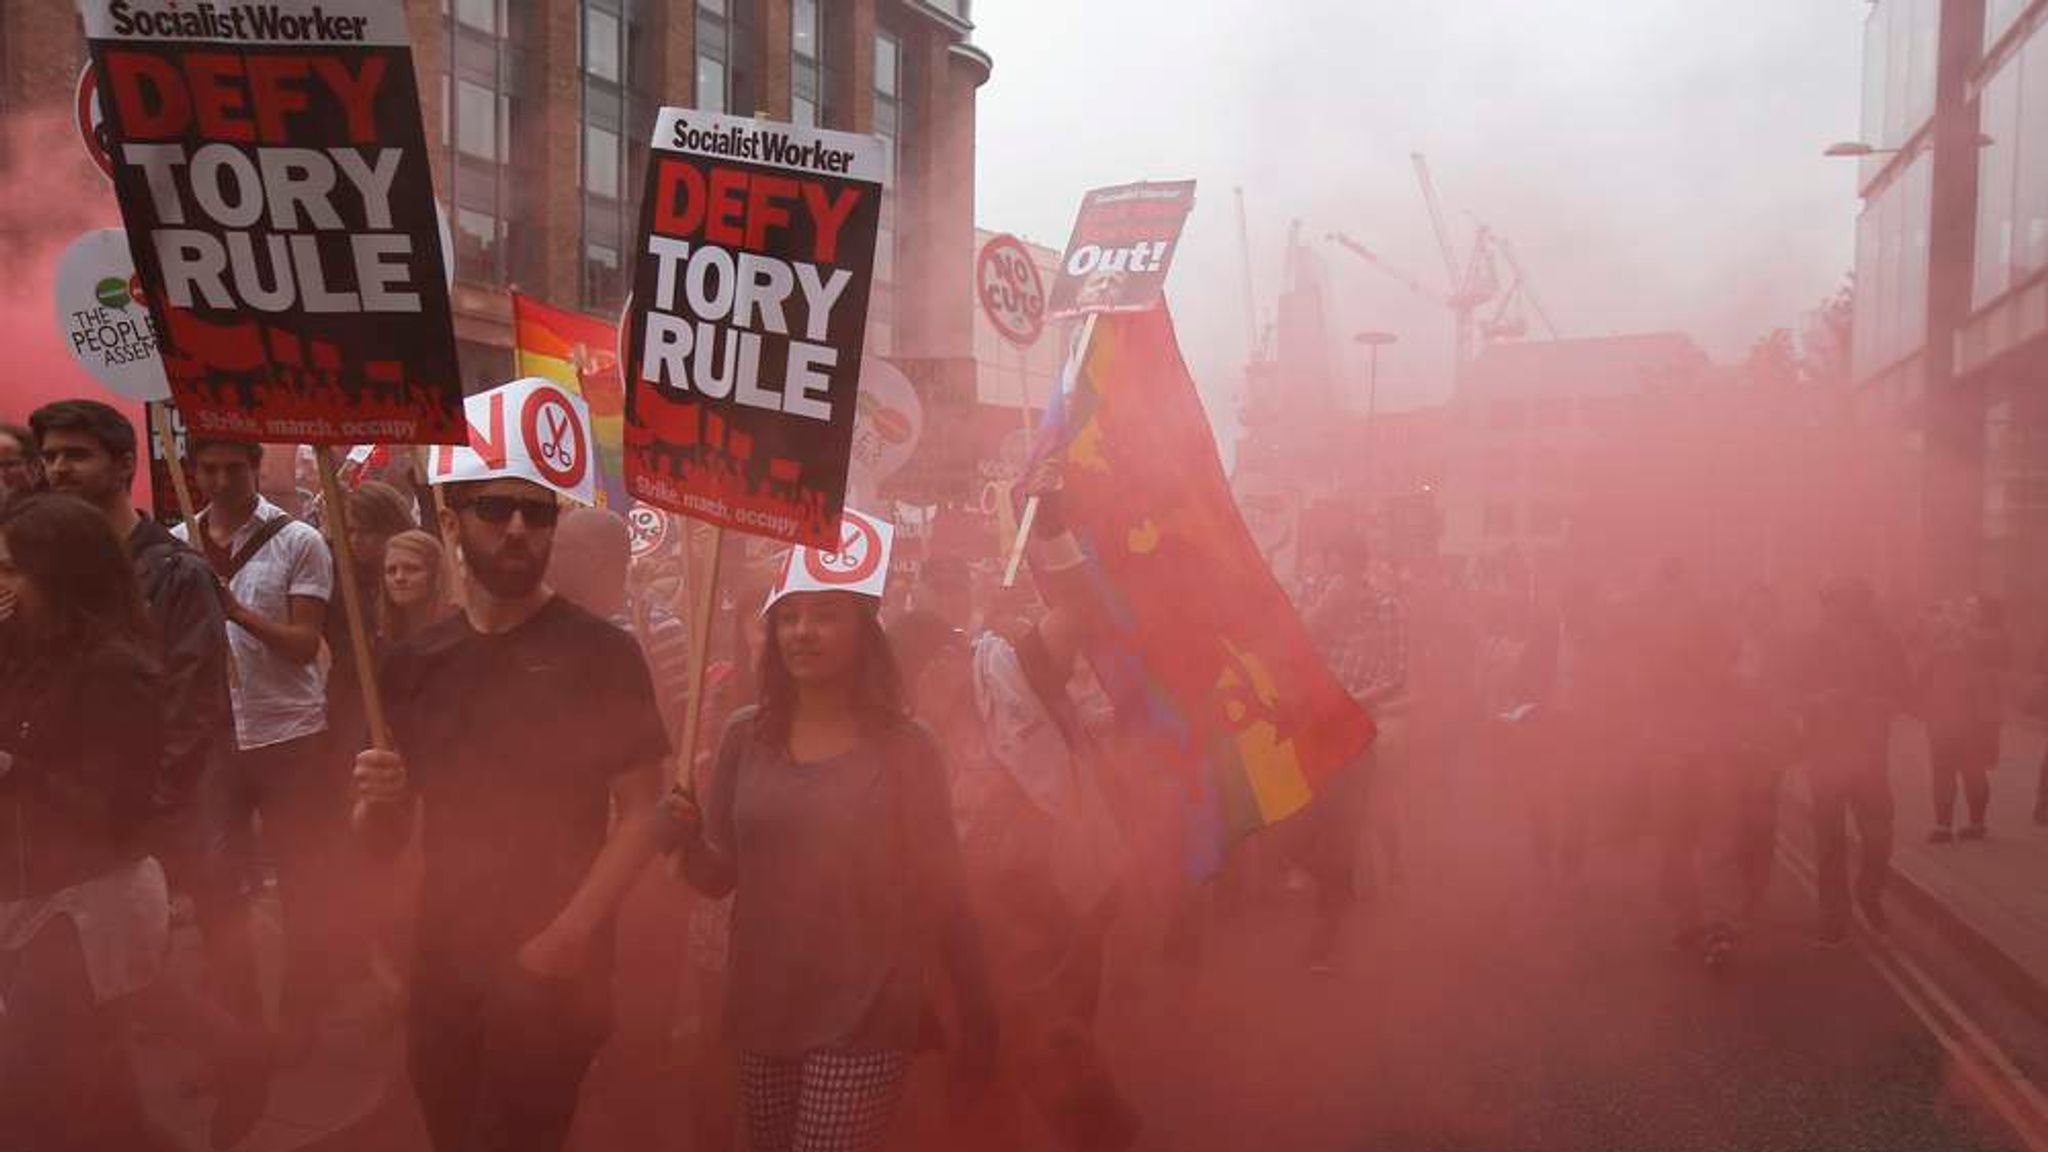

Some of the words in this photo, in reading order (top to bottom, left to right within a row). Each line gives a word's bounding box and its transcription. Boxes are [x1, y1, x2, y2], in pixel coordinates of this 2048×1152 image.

[106, 53, 387, 143] DEFY
[122, 142, 402, 230] TORY
[656, 159, 862, 263] DEFY
[151, 229, 422, 313] RULE
[648, 235, 852, 342] TORY
[994, 252, 1029, 284] NO
[1067, 241, 1168, 276] Out!
[72, 307, 111, 328] THE
[642, 312, 837, 421] RULE
[342, 417, 417, 439] occupy
[736, 507, 799, 535] occupy
